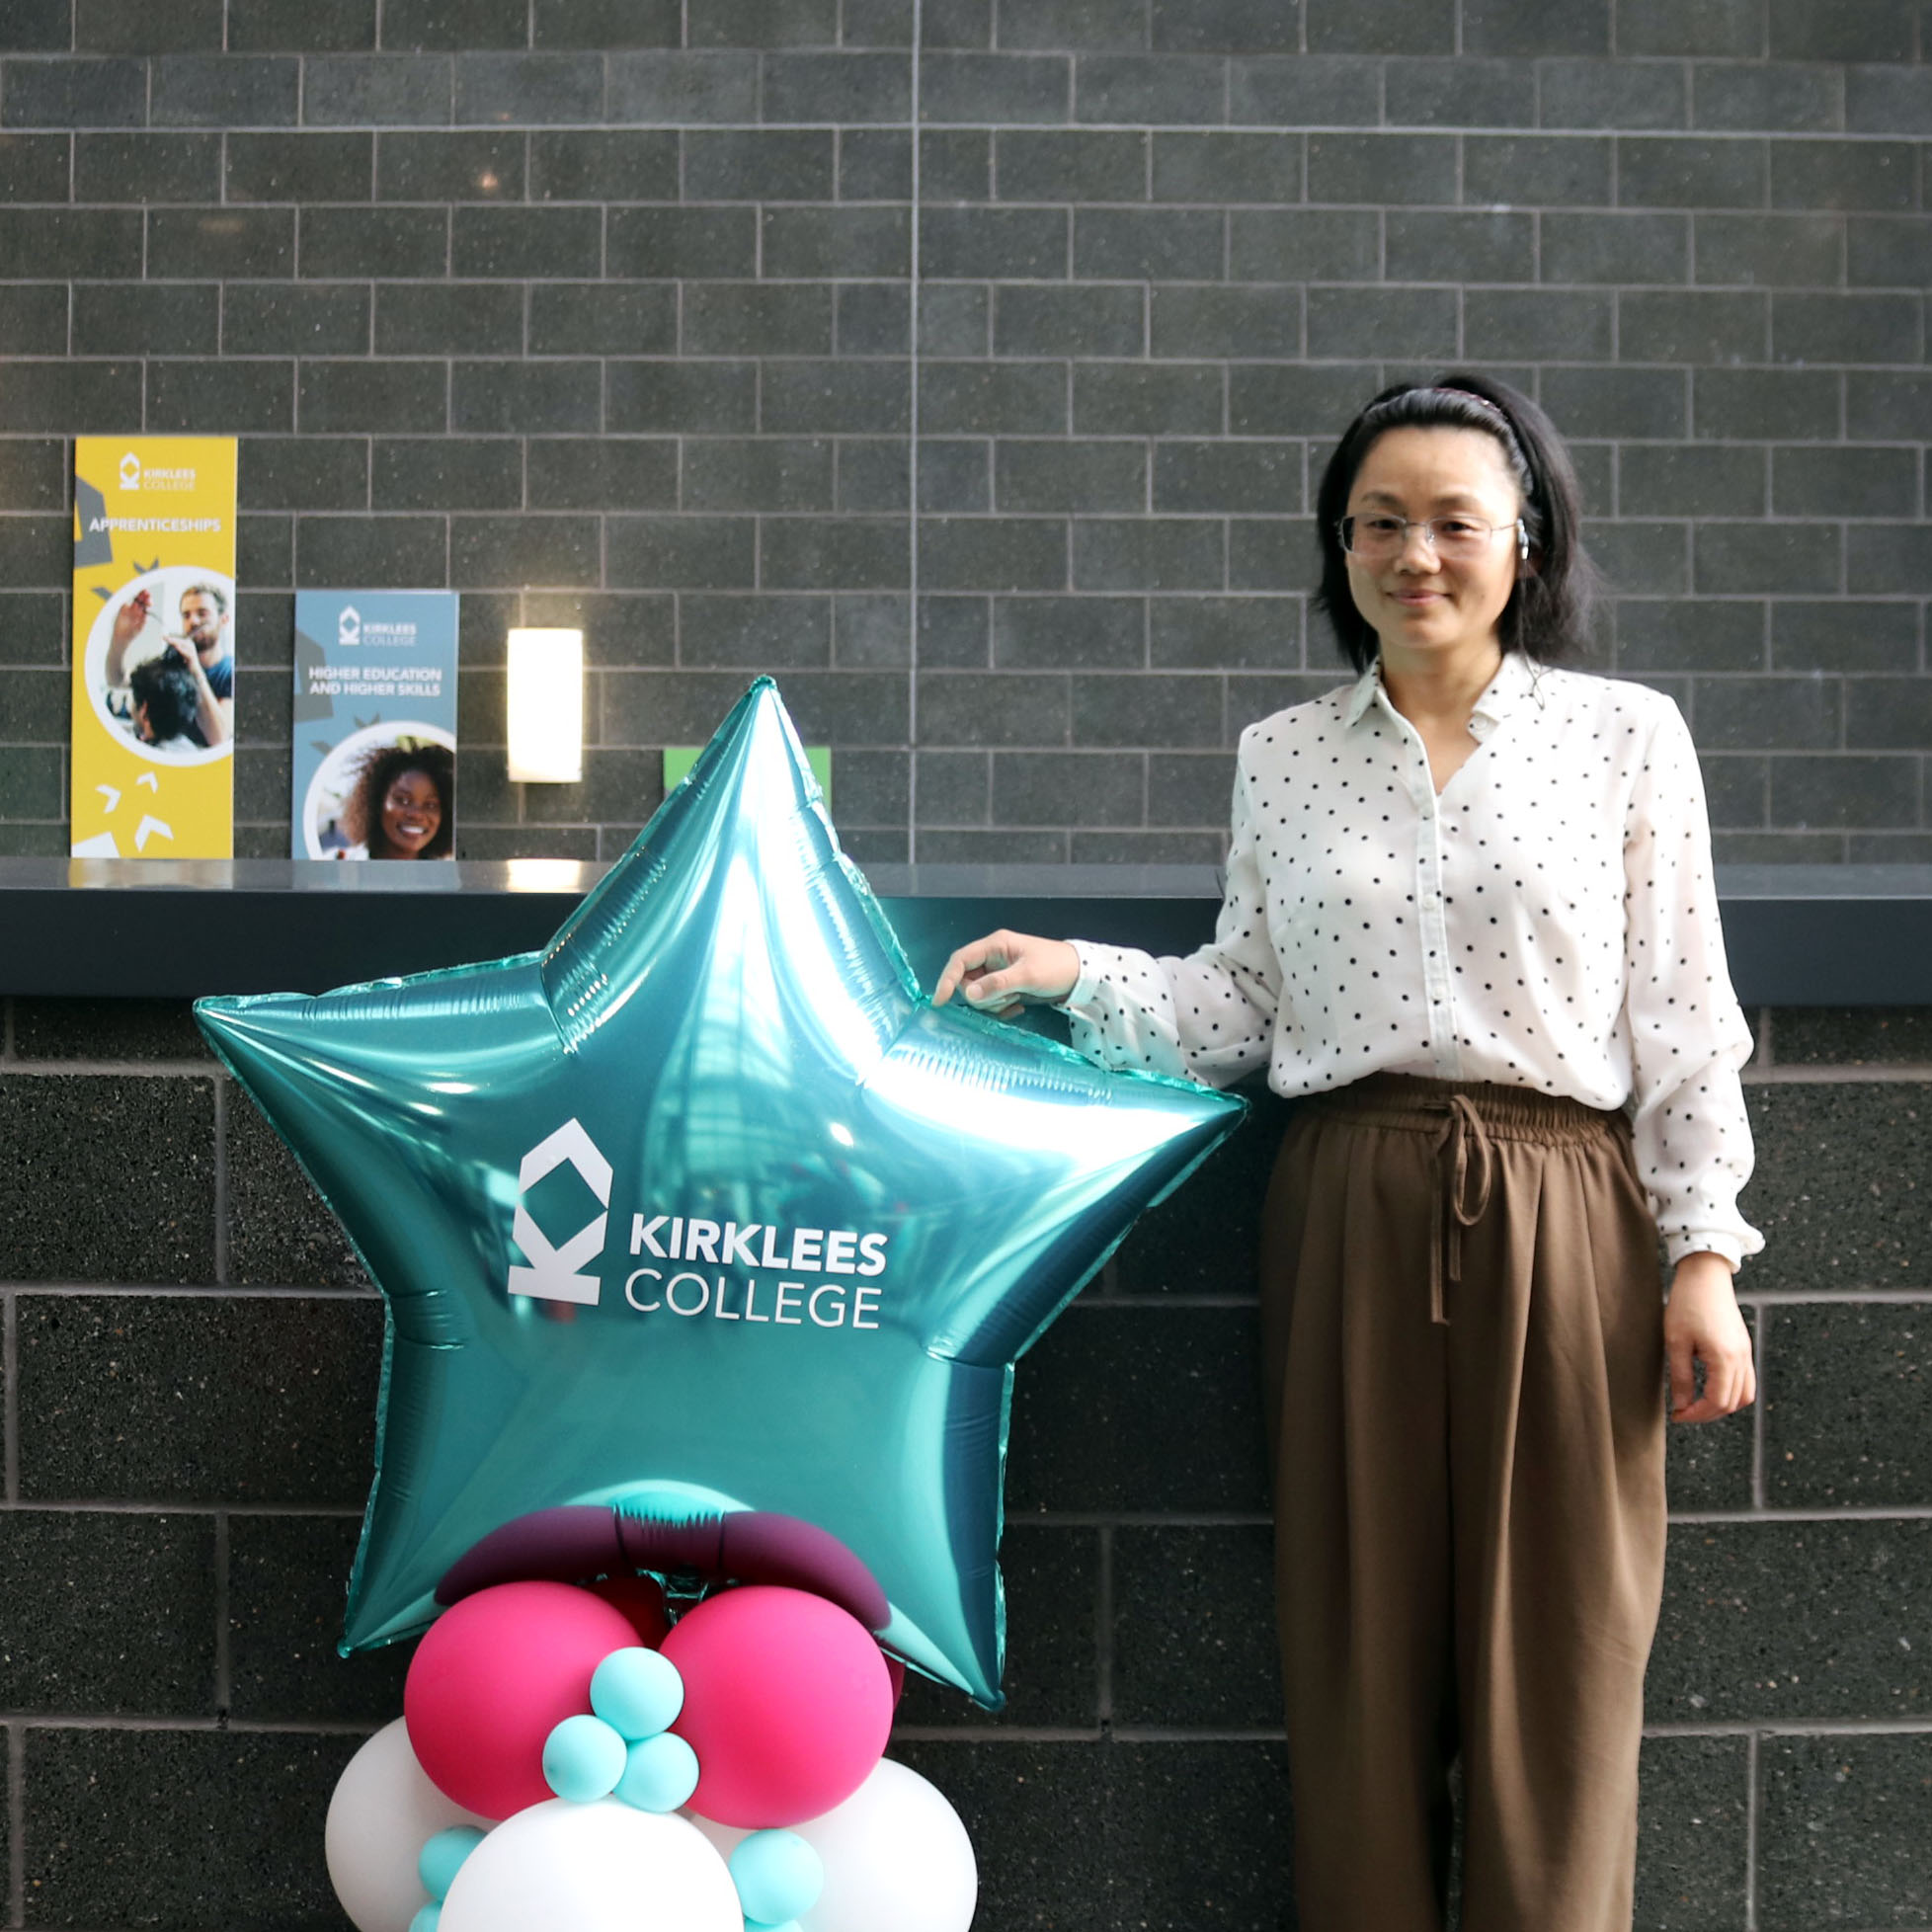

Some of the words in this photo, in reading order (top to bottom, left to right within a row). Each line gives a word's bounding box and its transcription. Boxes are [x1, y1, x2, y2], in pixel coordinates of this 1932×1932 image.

[143, 468, 196, 479] KIRKLEES
[143, 480, 196, 491] COLLEGE
[89, 517, 221, 532] APPRENTICESHIPS
[362, 623, 417, 635] KIRKLEES
[362, 635, 417, 646] COLLEGE
[308, 667, 361, 681] HIGHER
[363, 667, 443, 682] EDUCATION
[309, 682, 341, 695] AND
[345, 683, 395, 696] HIGHER
[398, 684, 442, 697] SKILLS
[629, 1213, 888, 1276] KIRKLEES
[624, 1268, 882, 1329] COLLEGE
